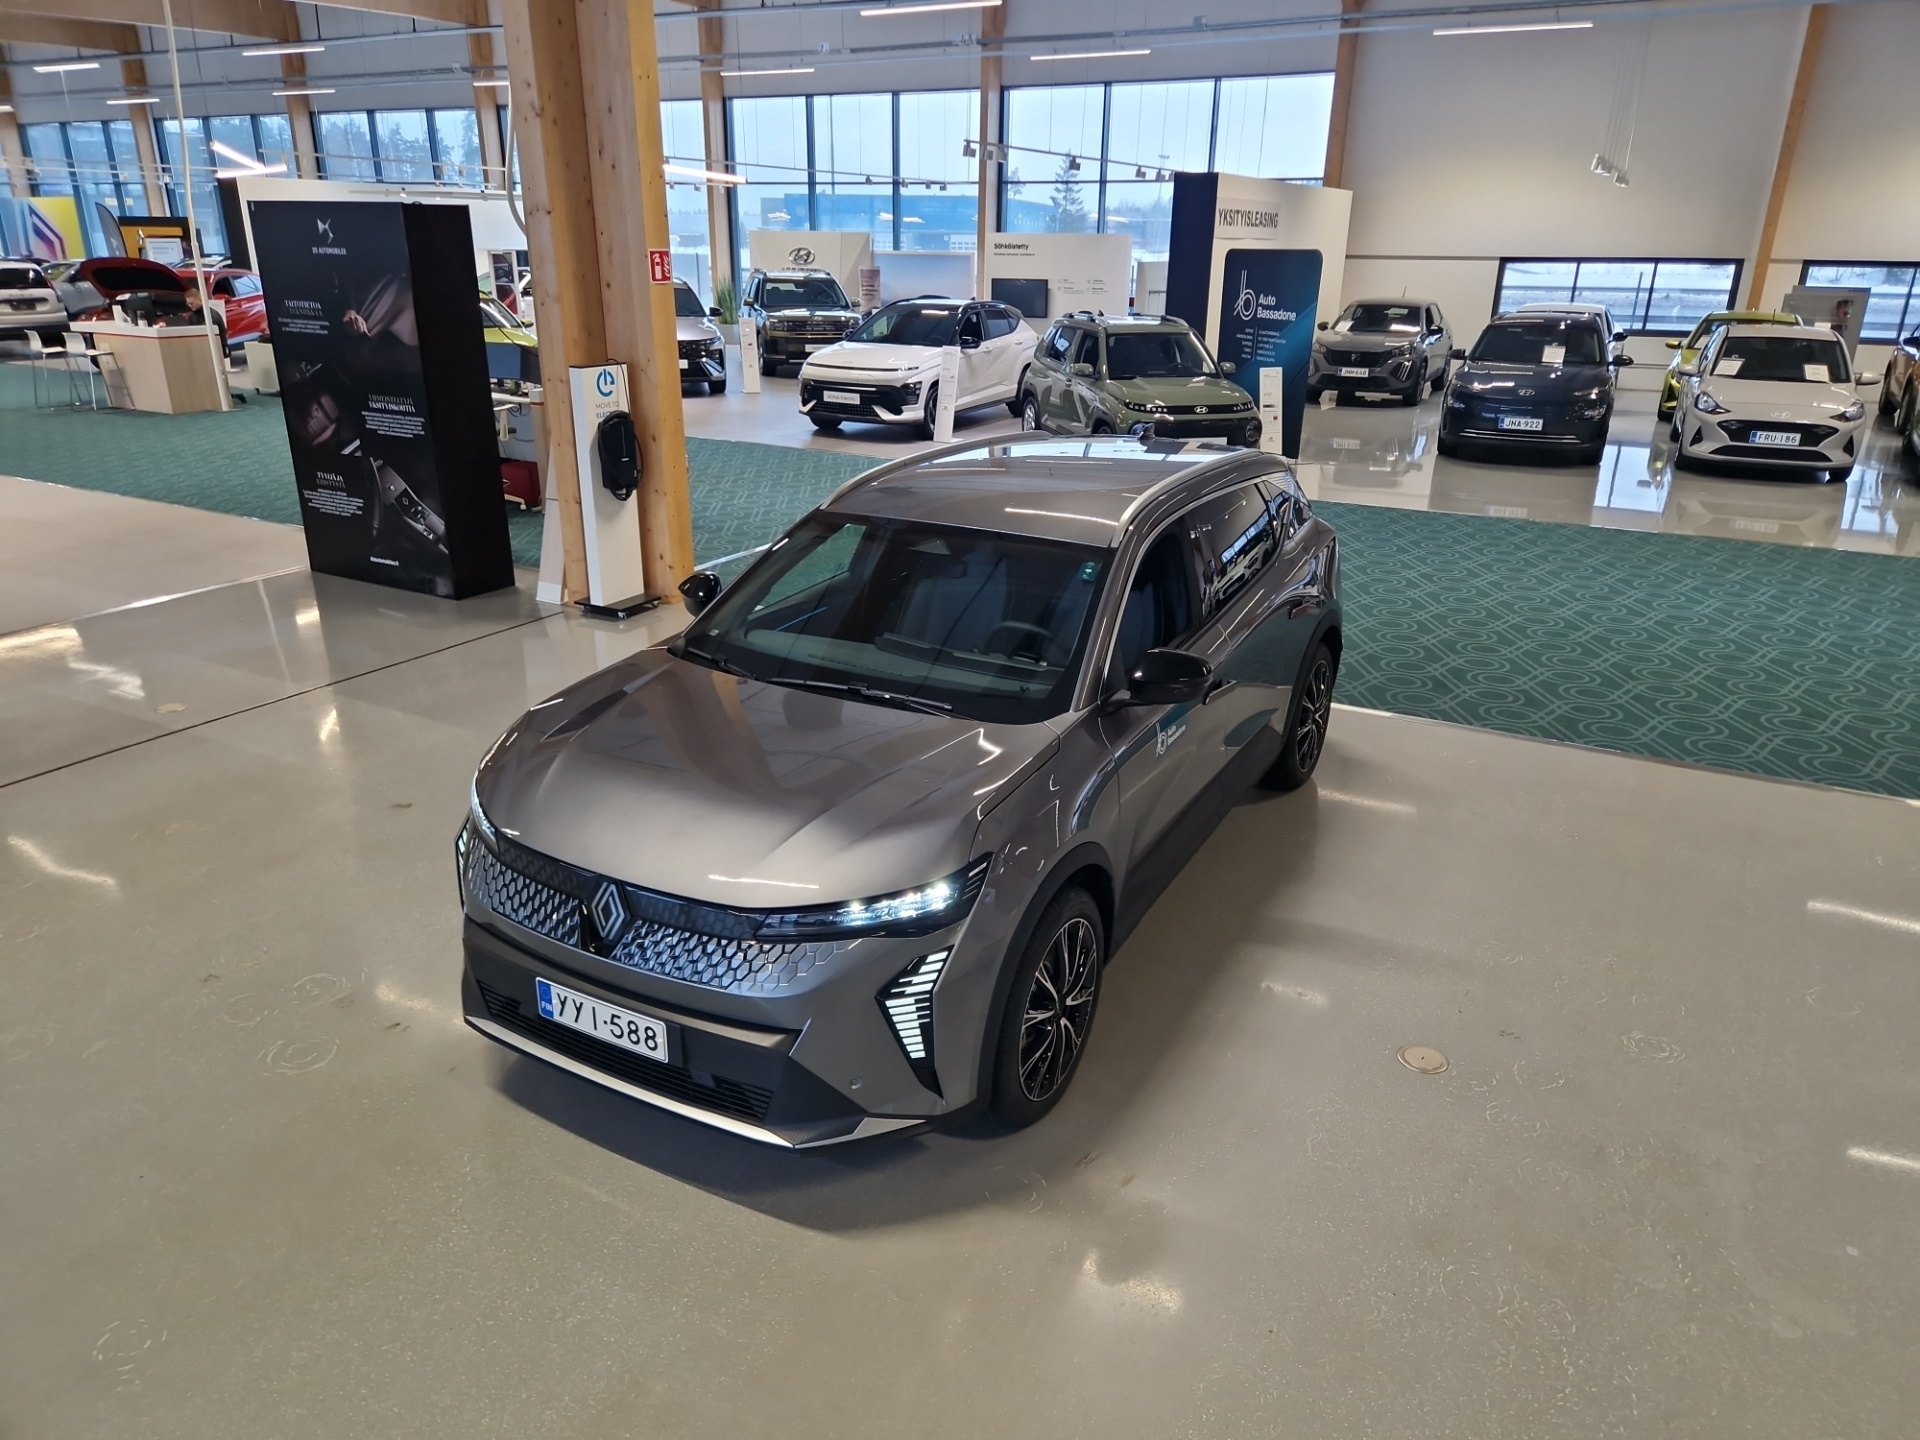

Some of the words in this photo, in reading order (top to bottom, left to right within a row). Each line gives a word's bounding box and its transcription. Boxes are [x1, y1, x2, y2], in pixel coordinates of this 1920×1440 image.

[1218, 208, 1279, 229] YKSITYISLEASING
[1258, 293, 1276, 306] Auto
[1257, 306, 1297, 321] Bassadone
[595, 401, 611, 409] MOVE
[612, 400, 620, 408] TO
[1505, 419, 1541, 429] JNA-922
[1757, 433, 1798, 444] FRU-186
[541, 1001, 553, 1012] FIN
[556, 992, 659, 1052] YYI-588
